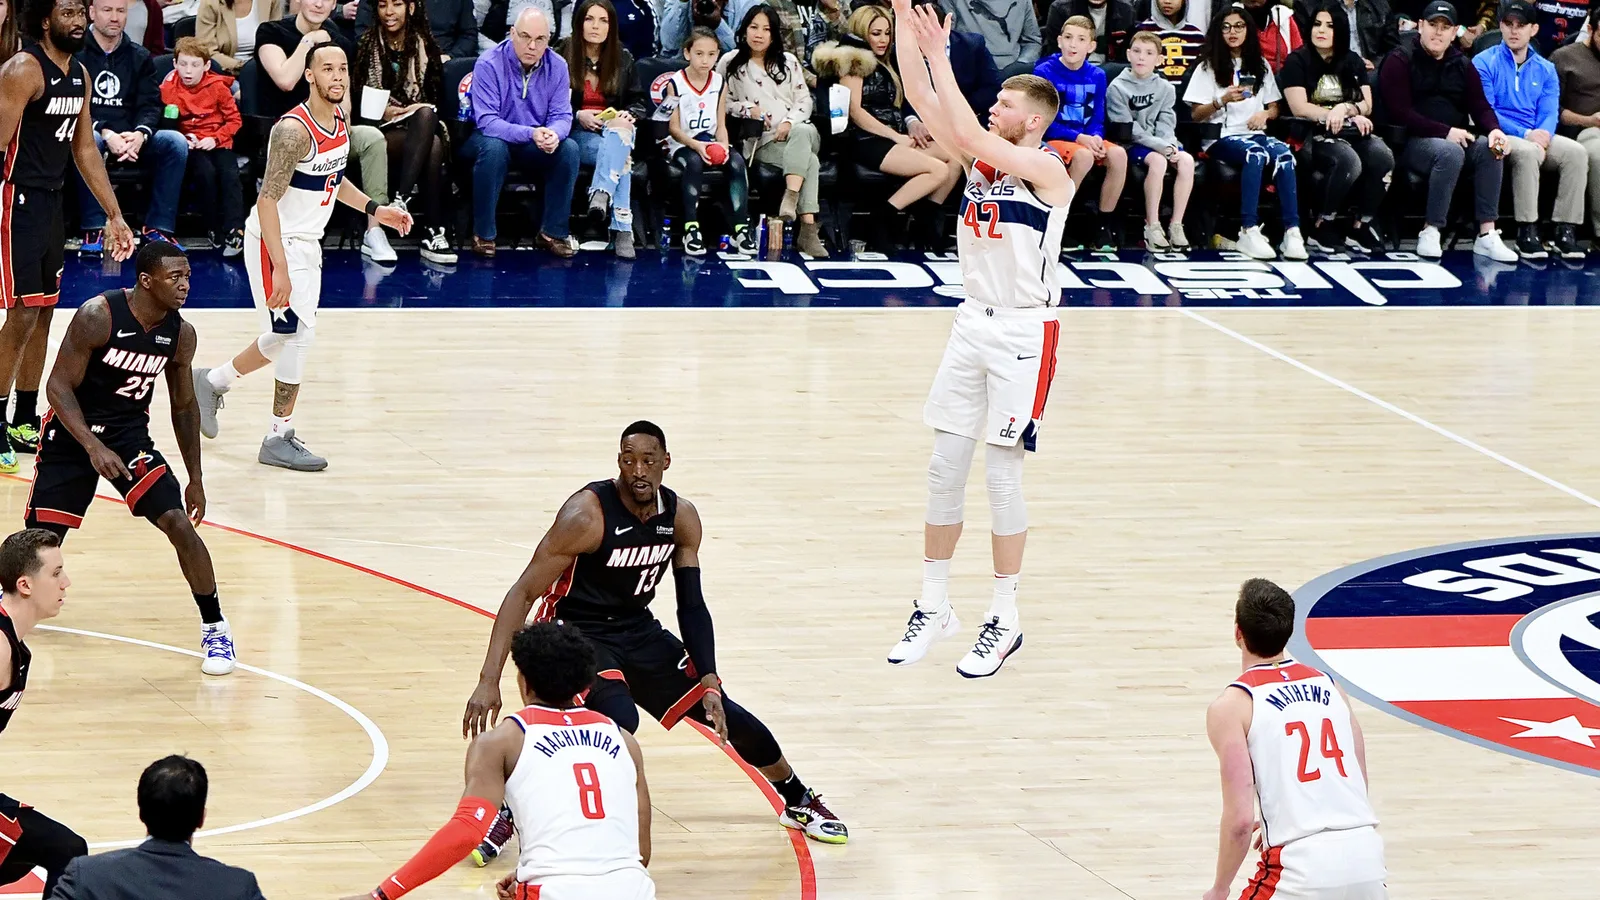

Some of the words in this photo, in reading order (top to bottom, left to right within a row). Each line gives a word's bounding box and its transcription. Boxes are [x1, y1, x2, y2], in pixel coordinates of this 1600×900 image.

[45, 96, 84, 115] MIAM
[1132, 92, 1155, 105] NIKE
[320, 172, 338, 207] 5
[964, 202, 1003, 239] 42
[102, 347, 168, 375] MIAMI
[115, 376, 155, 400] 25
[606, 543, 676, 567] MIAMI
[633, 564, 660, 596] 13
[1265, 683, 1332, 712] MATHEWS
[533, 730, 621, 760] HACHIMURA
[1285, 717, 1349, 783] 24
[572, 762, 606, 820] 8
